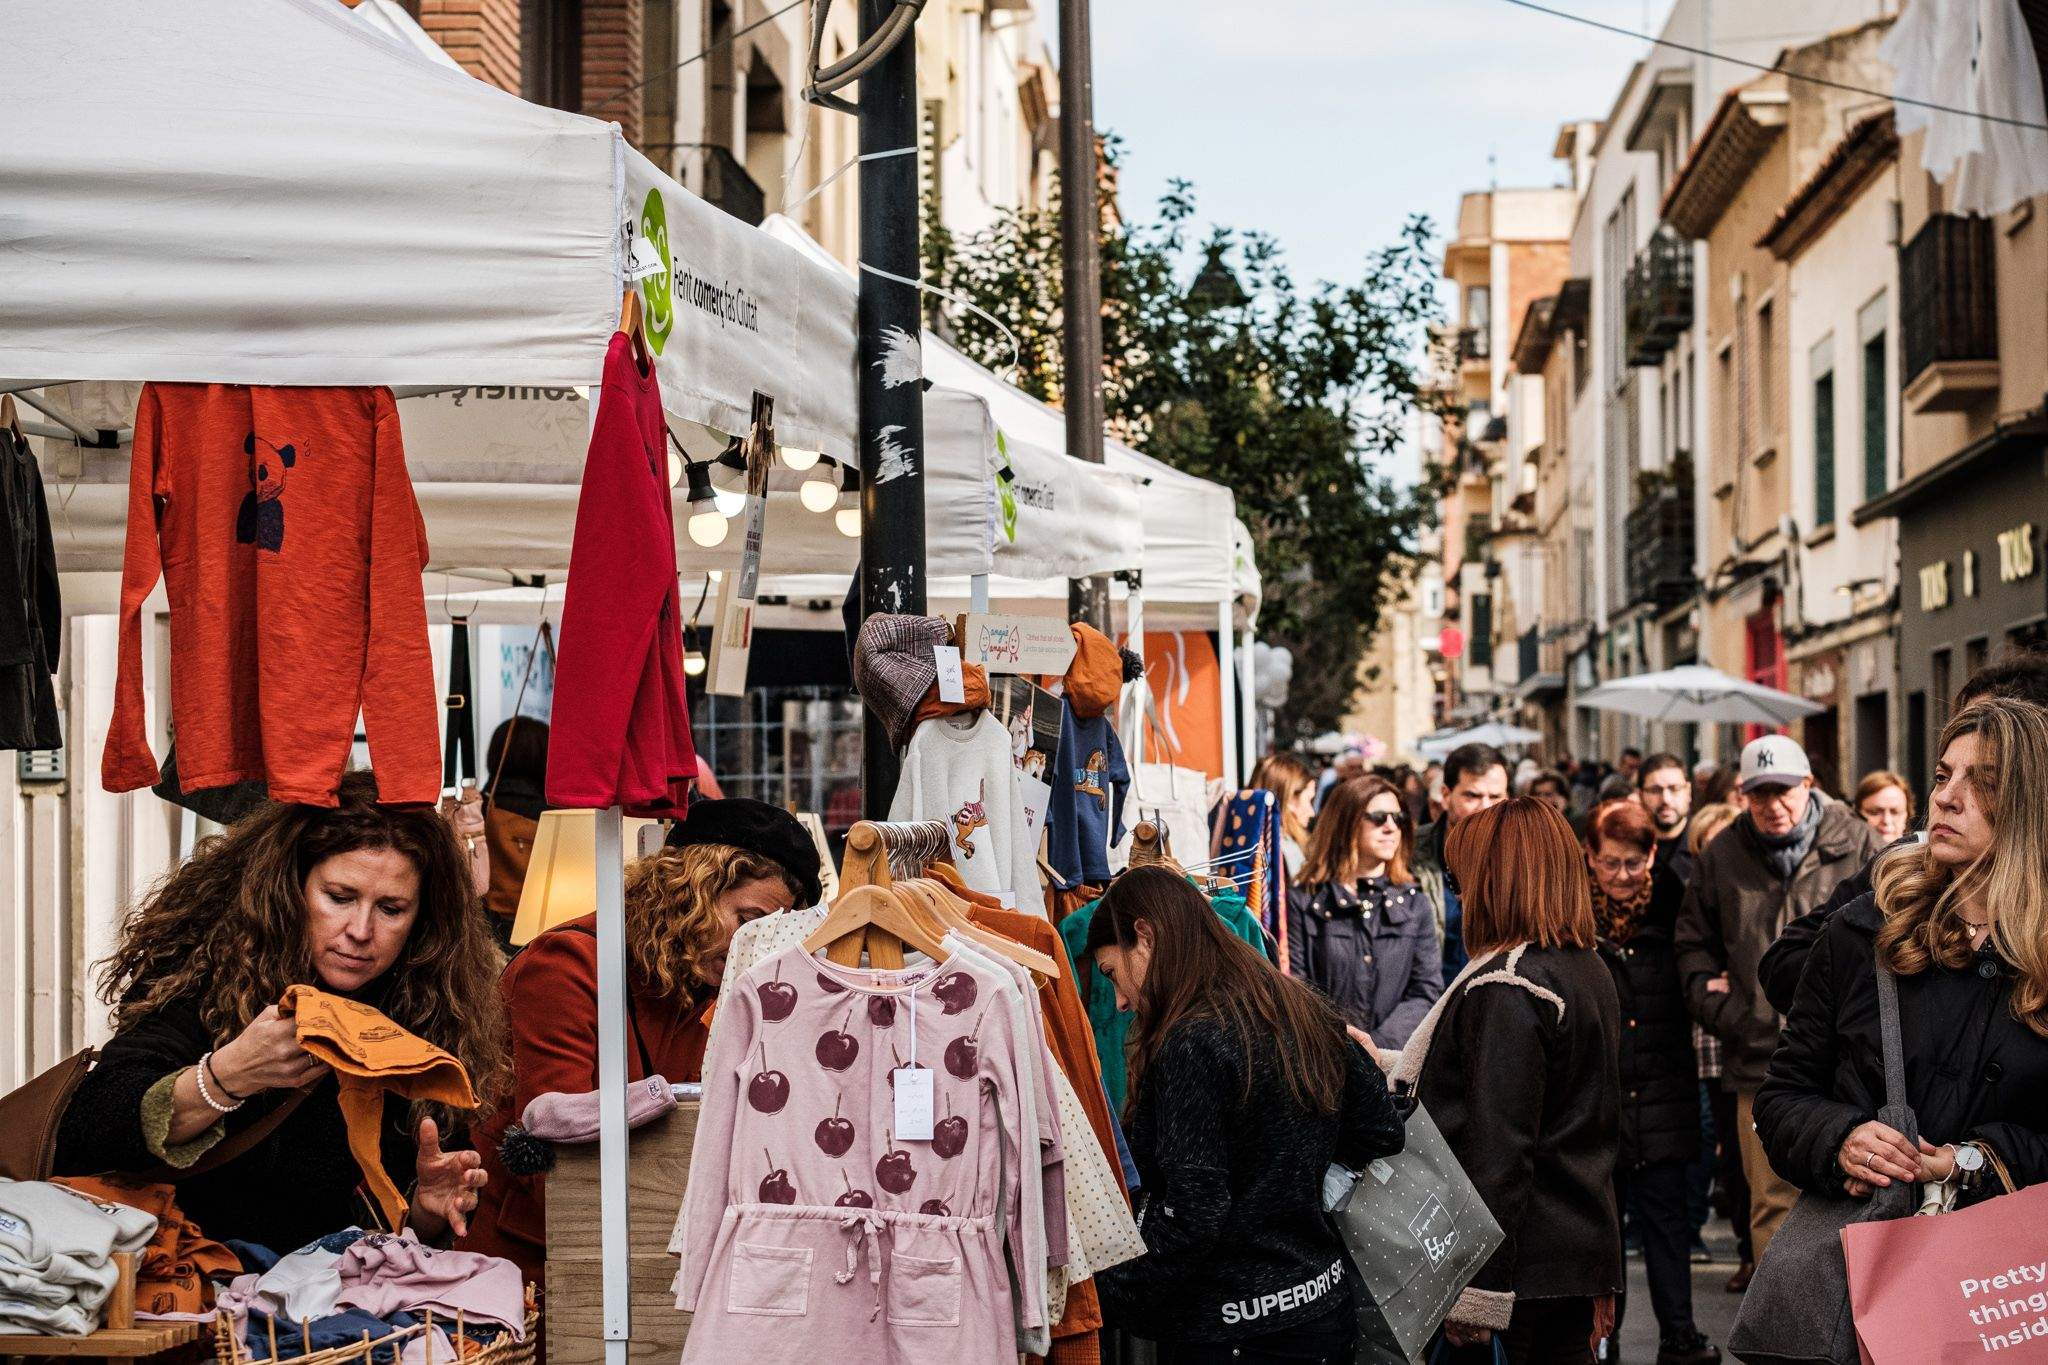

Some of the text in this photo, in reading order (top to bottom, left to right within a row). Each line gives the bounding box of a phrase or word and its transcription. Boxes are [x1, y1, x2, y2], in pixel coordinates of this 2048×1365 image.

[674, 256, 758, 332] Fent comerç fas Ciutat
[1221, 1268, 1331, 1324] SUPERDRY
[1960, 1261, 2047, 1299] Pretty
[1969, 1291, 2048, 1325] thing
[1979, 1316, 2048, 1352] insid
